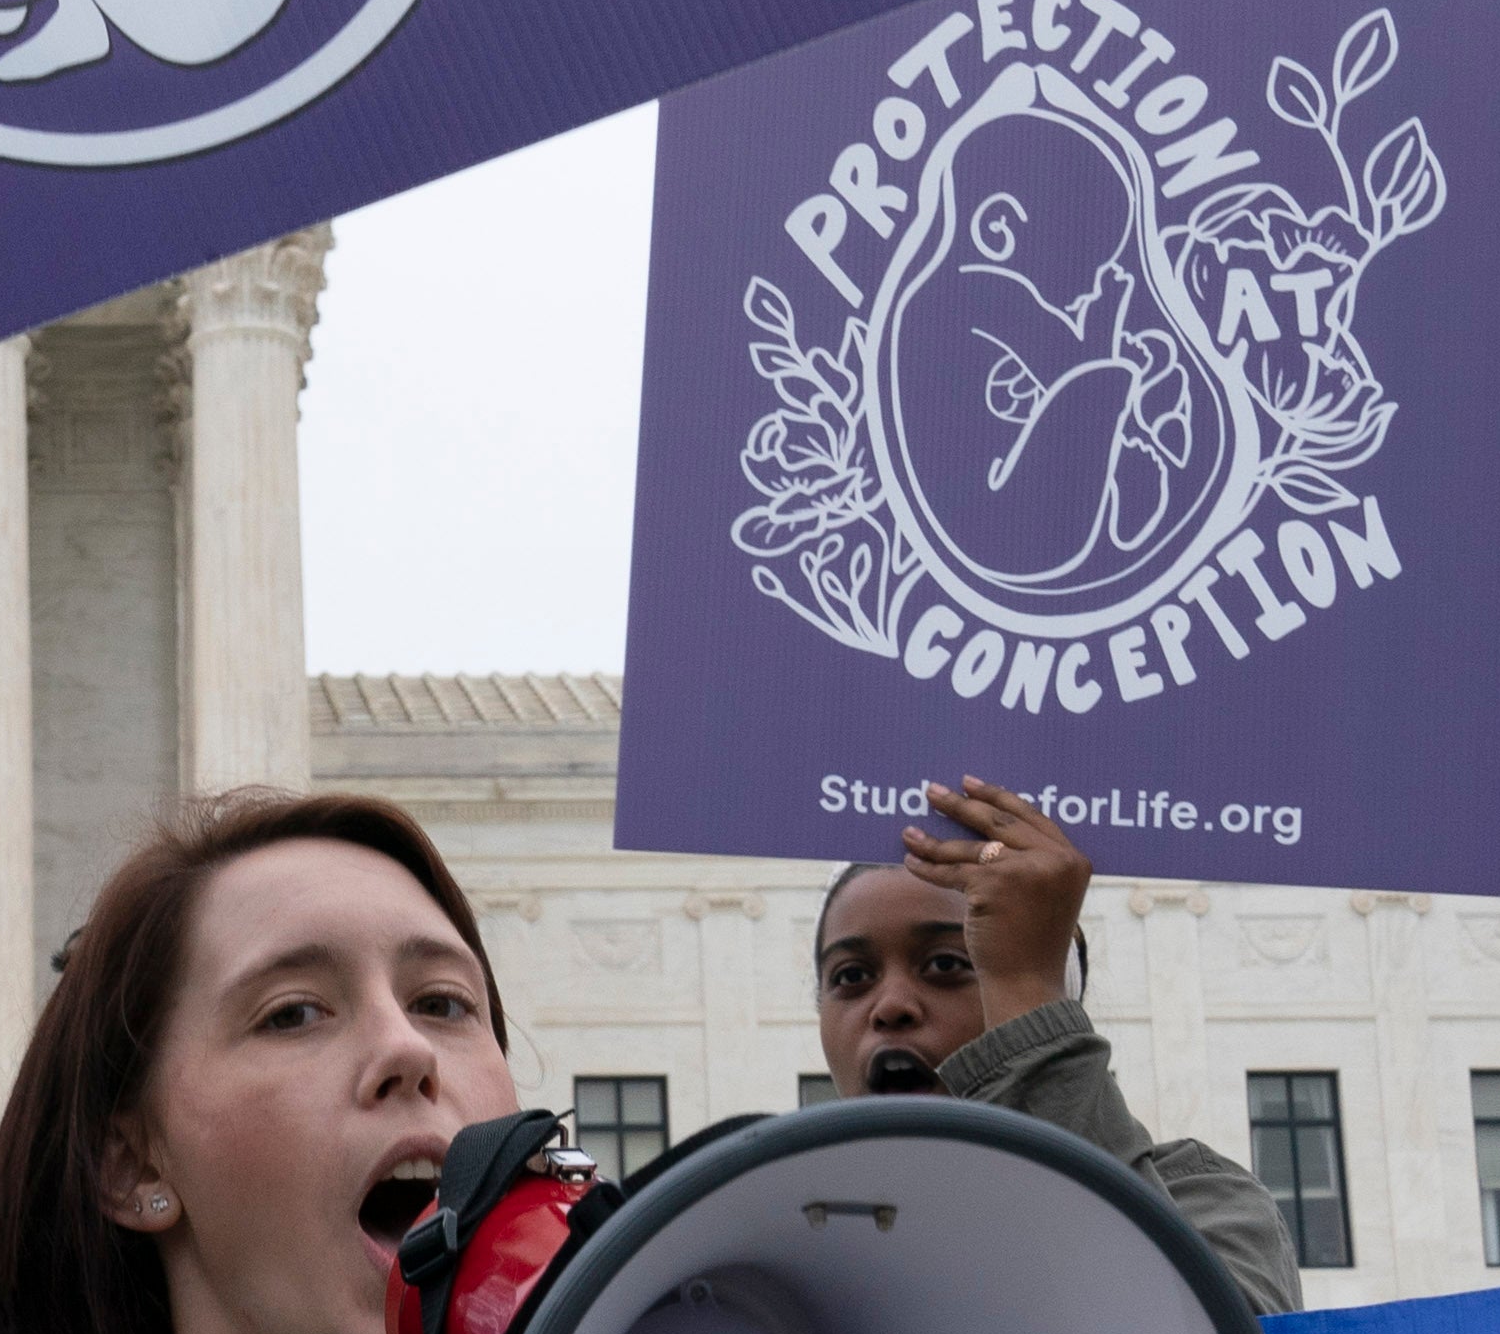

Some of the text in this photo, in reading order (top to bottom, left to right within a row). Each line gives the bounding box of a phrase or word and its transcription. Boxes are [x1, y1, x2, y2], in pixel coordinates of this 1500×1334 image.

[1219, 269, 1334, 346] AT
[903, 495, 1401, 715] CONCEPTION
[819, 774, 1302, 845] StudforLife.org
